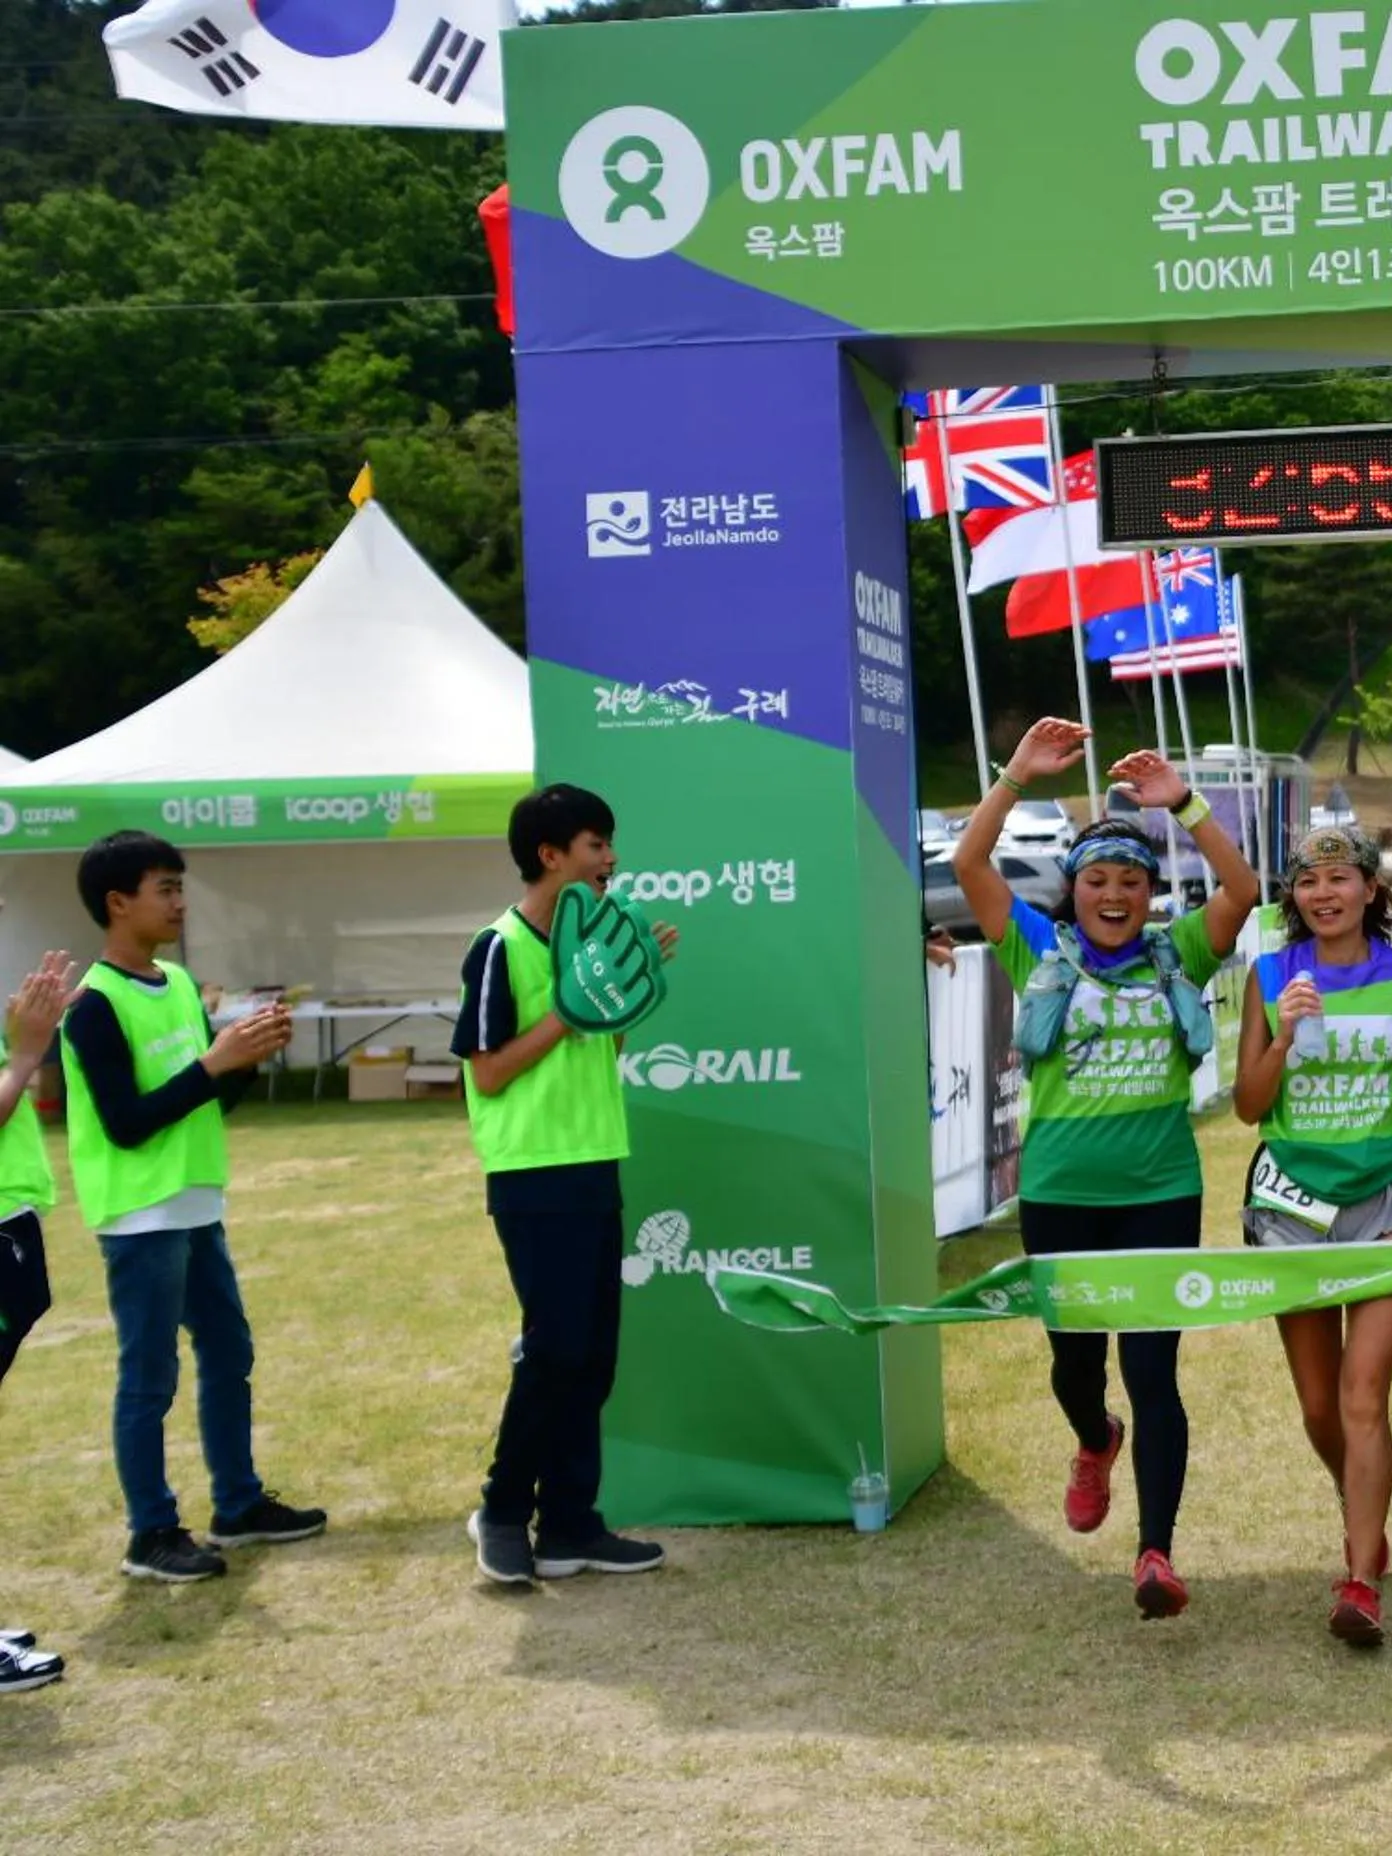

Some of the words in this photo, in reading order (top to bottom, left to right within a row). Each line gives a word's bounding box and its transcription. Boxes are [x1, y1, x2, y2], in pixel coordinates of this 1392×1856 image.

[740, 129, 963, 203] OXFAM
[1152, 181, 1301, 241] 옥스팜
[744, 221, 845, 260] 옥스팜
[1154, 255, 1273, 292] 100KM
[660, 493, 779, 528] 전라남도
[662, 526, 780, 547] JeollaNamdo
[855, 570, 902, 636] OXFAM
[733, 687, 789, 724] 구례
[163, 795, 257, 827] 아이쿱
[617, 1044, 802, 1090] KORAIL
[1288, 1073, 1389, 1099] OXFAM
[1288, 1096, 1391, 1115] TRAILWALKER
[1220, 1278, 1276, 1297] OXFAM
